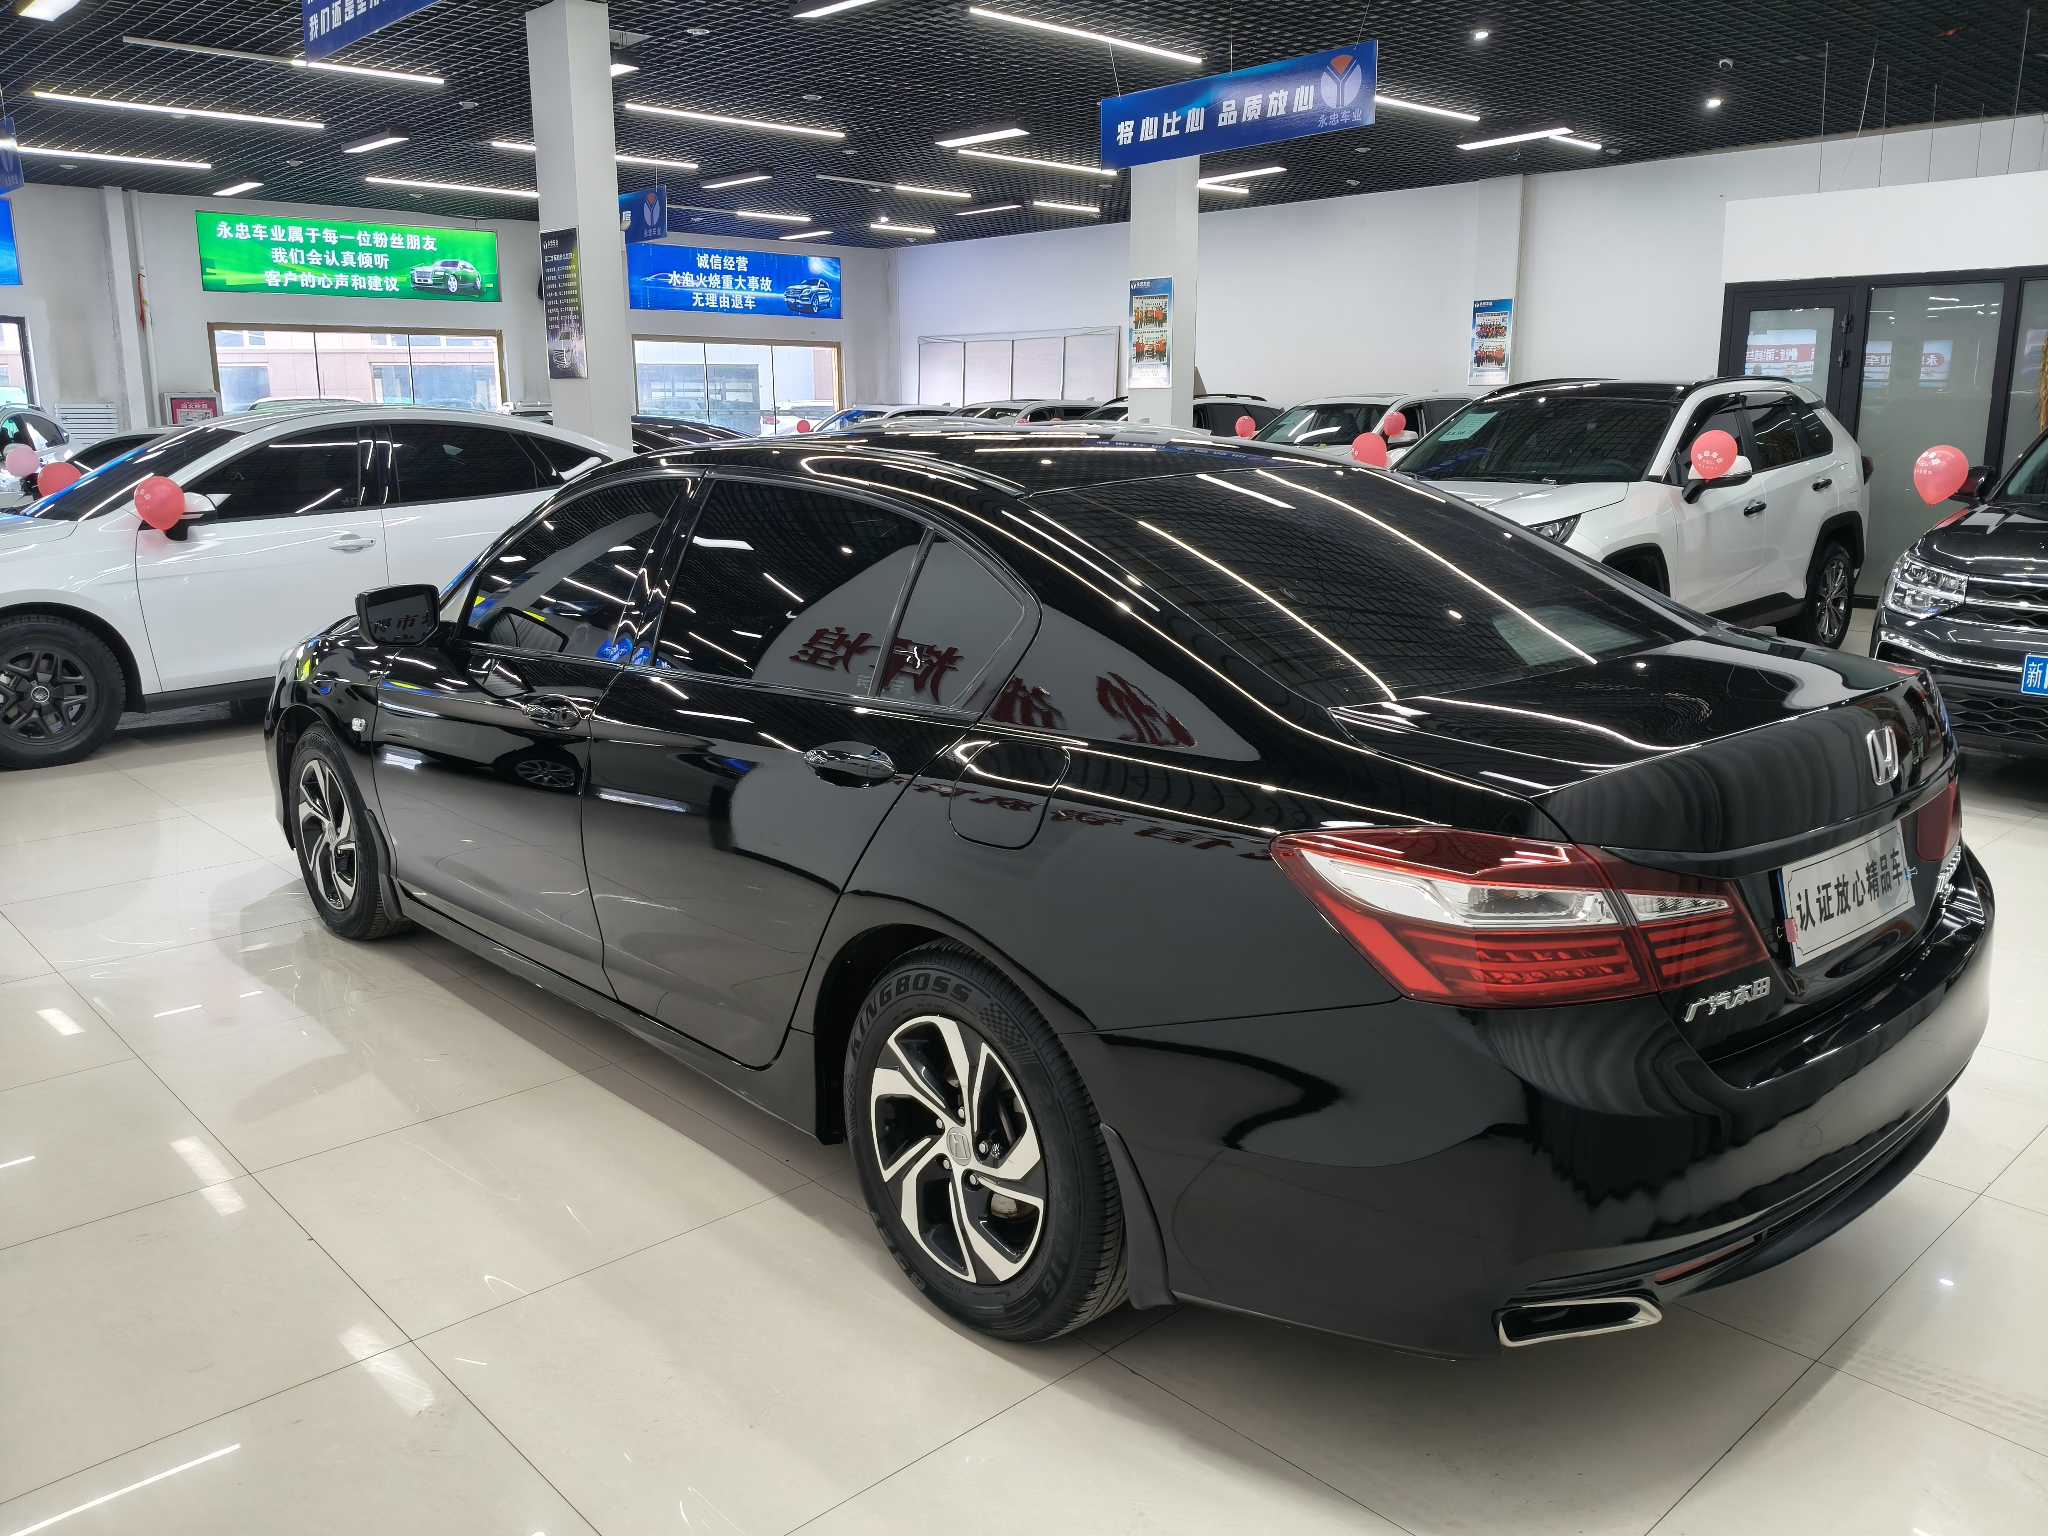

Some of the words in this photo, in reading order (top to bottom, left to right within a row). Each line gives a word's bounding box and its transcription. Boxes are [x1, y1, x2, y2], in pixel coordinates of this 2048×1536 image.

[1117, 107, 1205, 146] 将心比心
[1217, 85, 1315, 127] 品质放心
[1318, 110, 1363, 129] 永忠车业
[216, 221, 438, 252] 永忠车业属于每一位粉丝朋友
[271, 247, 390, 271] 我们会认真倾听
[696, 253, 749, 272] 诚信经营
[264, 270, 400, 293] 客户的心声和建议
[668, 270, 772, 292] 水泡火烧重大事故
[692, 292, 757, 310] 无理由退车
[2026, 661, 2048, 689] 新
[1795, 849, 1903, 932] 认证放心精品车
[1684, 976, 1771, 1023] 广汽本田
